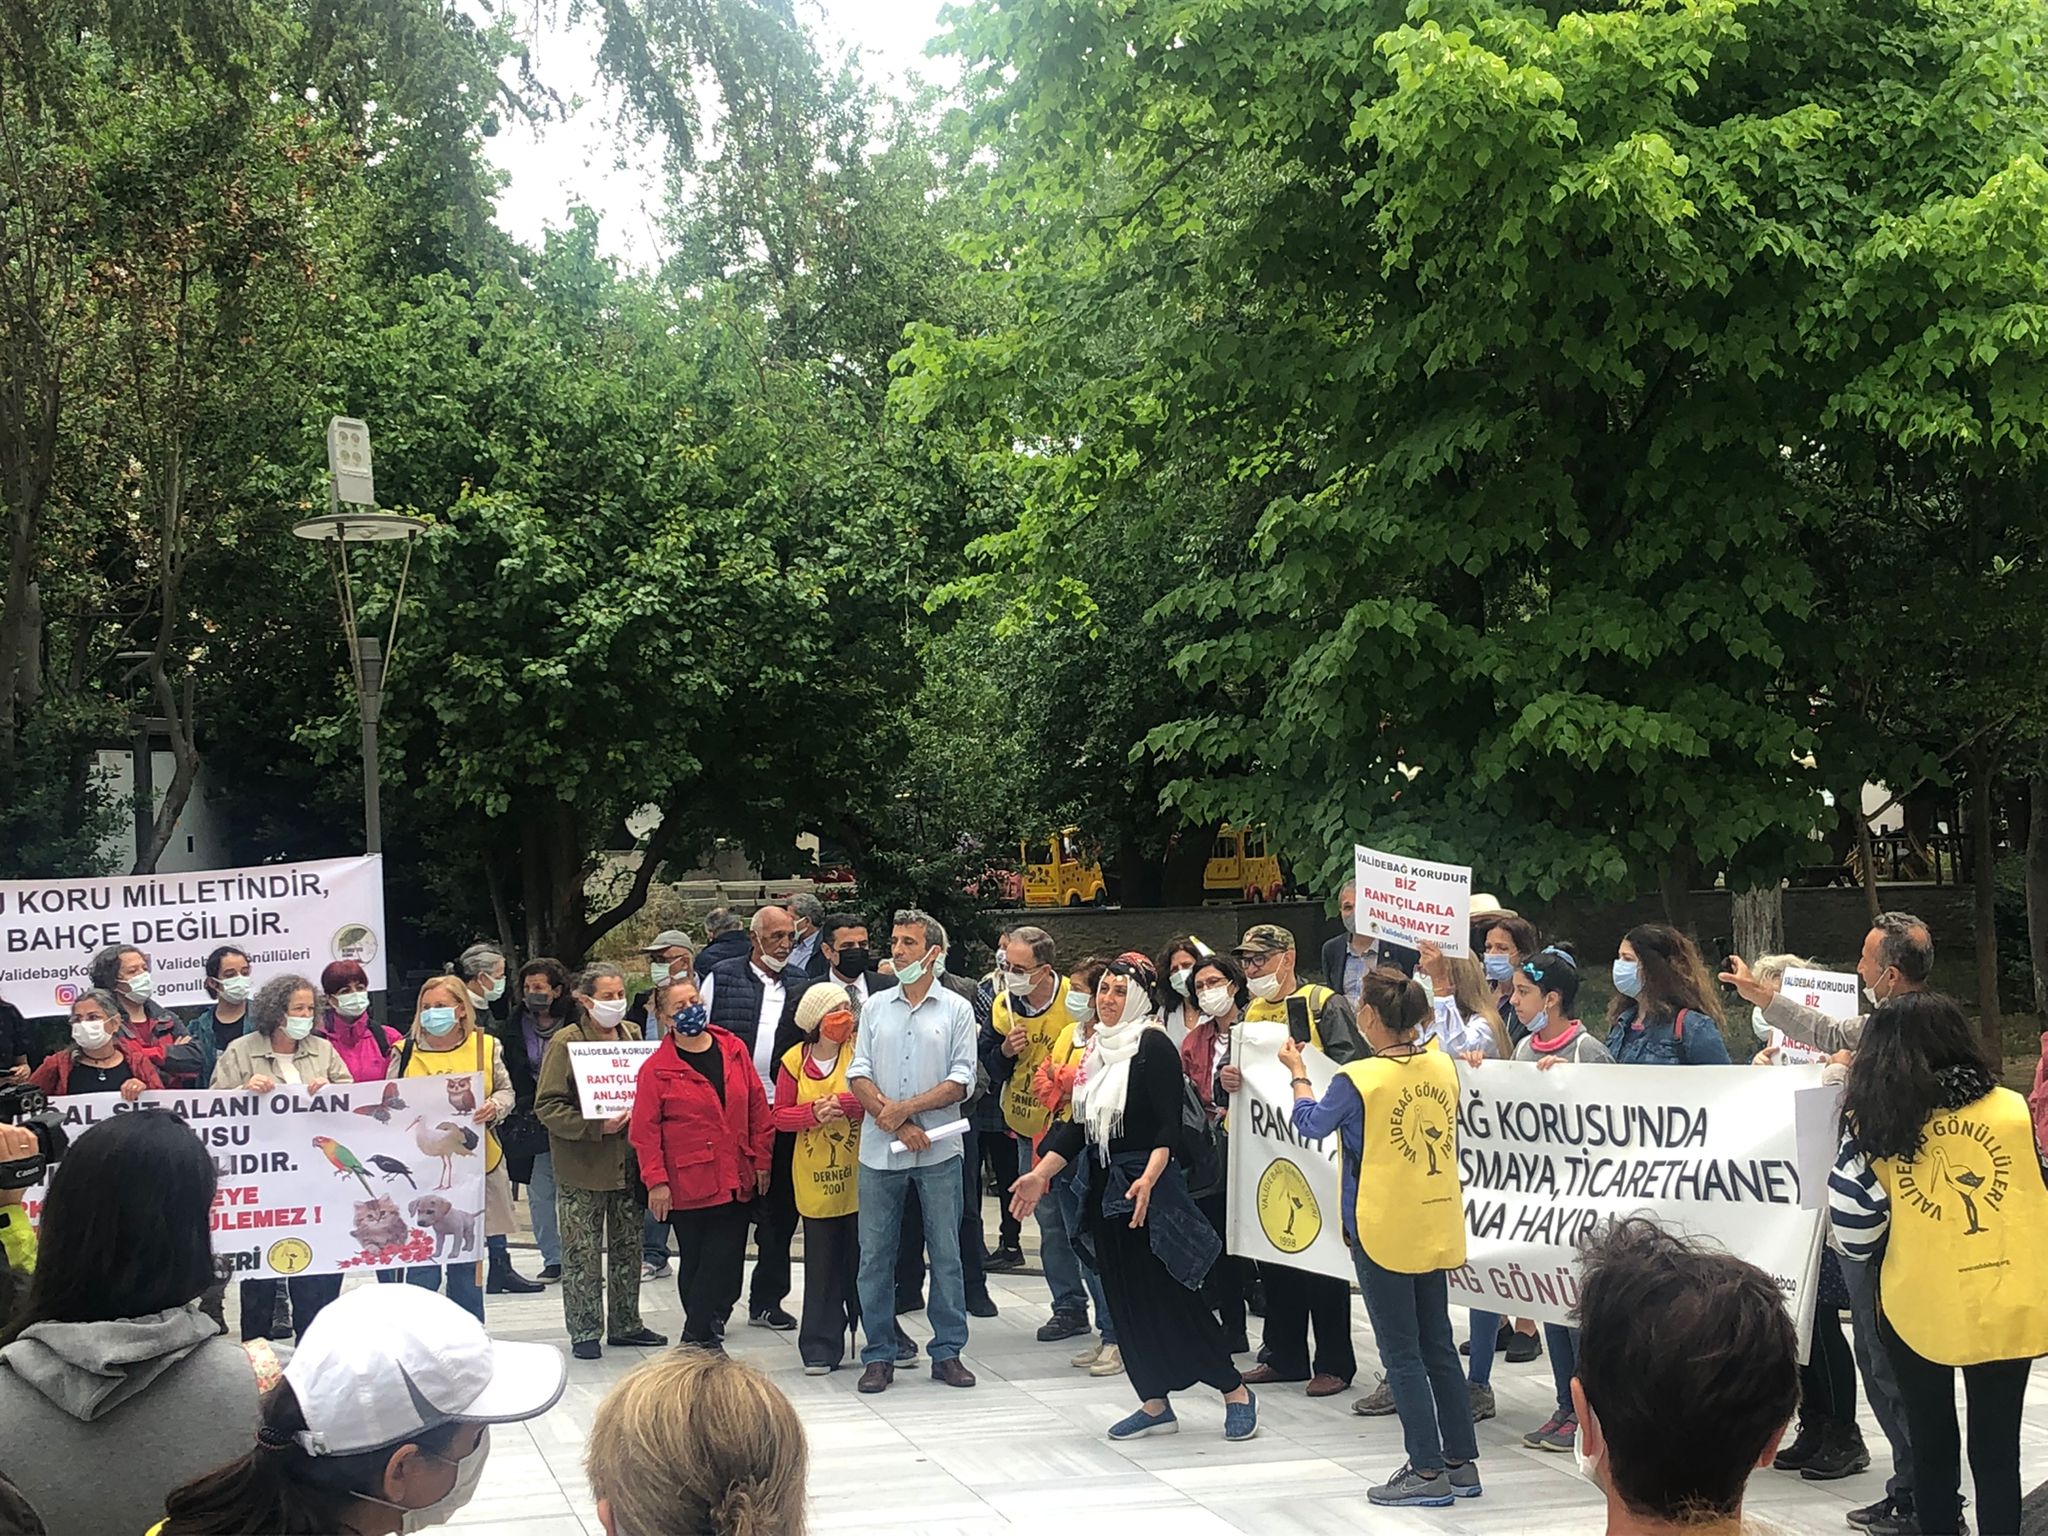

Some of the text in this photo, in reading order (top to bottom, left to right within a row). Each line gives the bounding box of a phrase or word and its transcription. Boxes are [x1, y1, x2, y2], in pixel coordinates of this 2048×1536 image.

[1357, 853, 1468, 885] VALİDEBAĞ KORUDUR
[18, 887, 111, 915] KORU
[124, 869, 329, 909] MİLLETİNDİR,
[1395, 876, 1417, 892] BİZ
[1364, 887, 1455, 917] RANTÇILARLA
[8, 908, 290, 953] BAHÇE DEĞİLDİR.
[1369, 907, 1450, 936] ANLAŞMAYIZ
[1805, 992, 1820, 1008] BİZ
[1816, 980, 1856, 994] KORUDUR
[612, 1056, 630, 1068] BİZ
[171, 1096, 259, 1119] ALANI
[270, 1093, 350, 1115] OLAN
[1390, 1086, 1417, 1163] VALİDEBAĞ
[1496, 1100, 1707, 1148] KORUSU'NDA
[15, 1166, 40, 1178] Canon
[1932, 1115, 2013, 1212] GÖNÜLLÜLERİ
[822, 1182, 845, 1196] 2001
